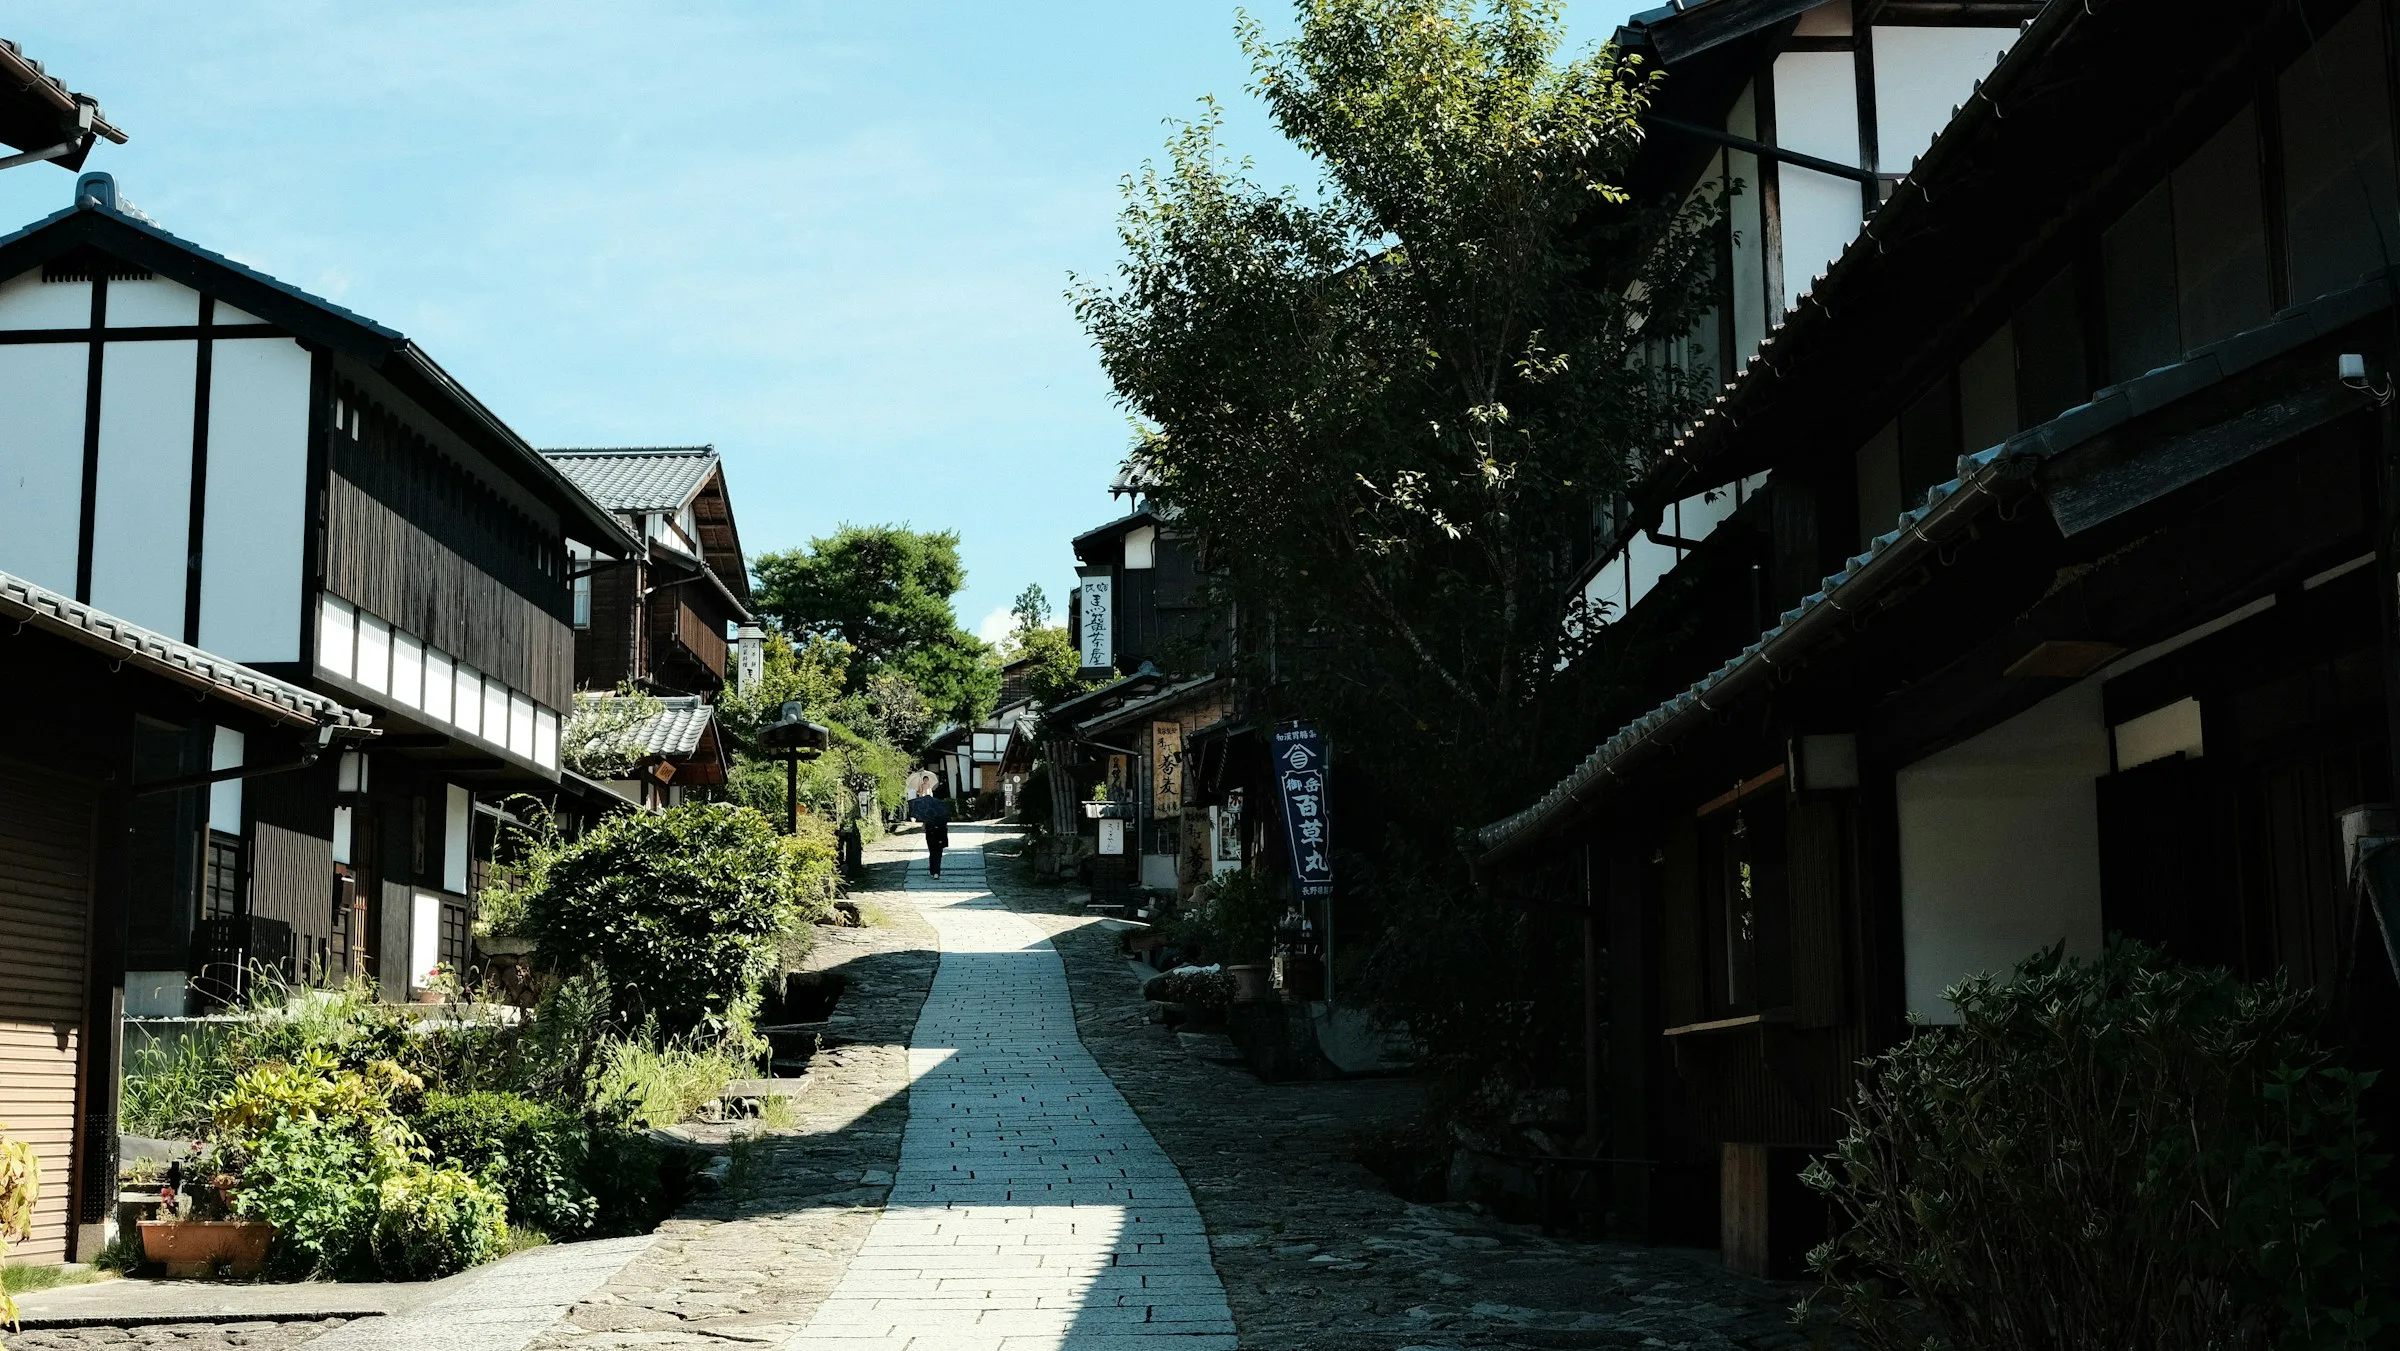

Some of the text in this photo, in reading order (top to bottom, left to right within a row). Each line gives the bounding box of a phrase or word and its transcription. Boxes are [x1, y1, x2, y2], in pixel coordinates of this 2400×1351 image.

[1084, 594, 1106, 666] 馬籠茶屋
[1291, 794, 1329, 873] 百草丸
